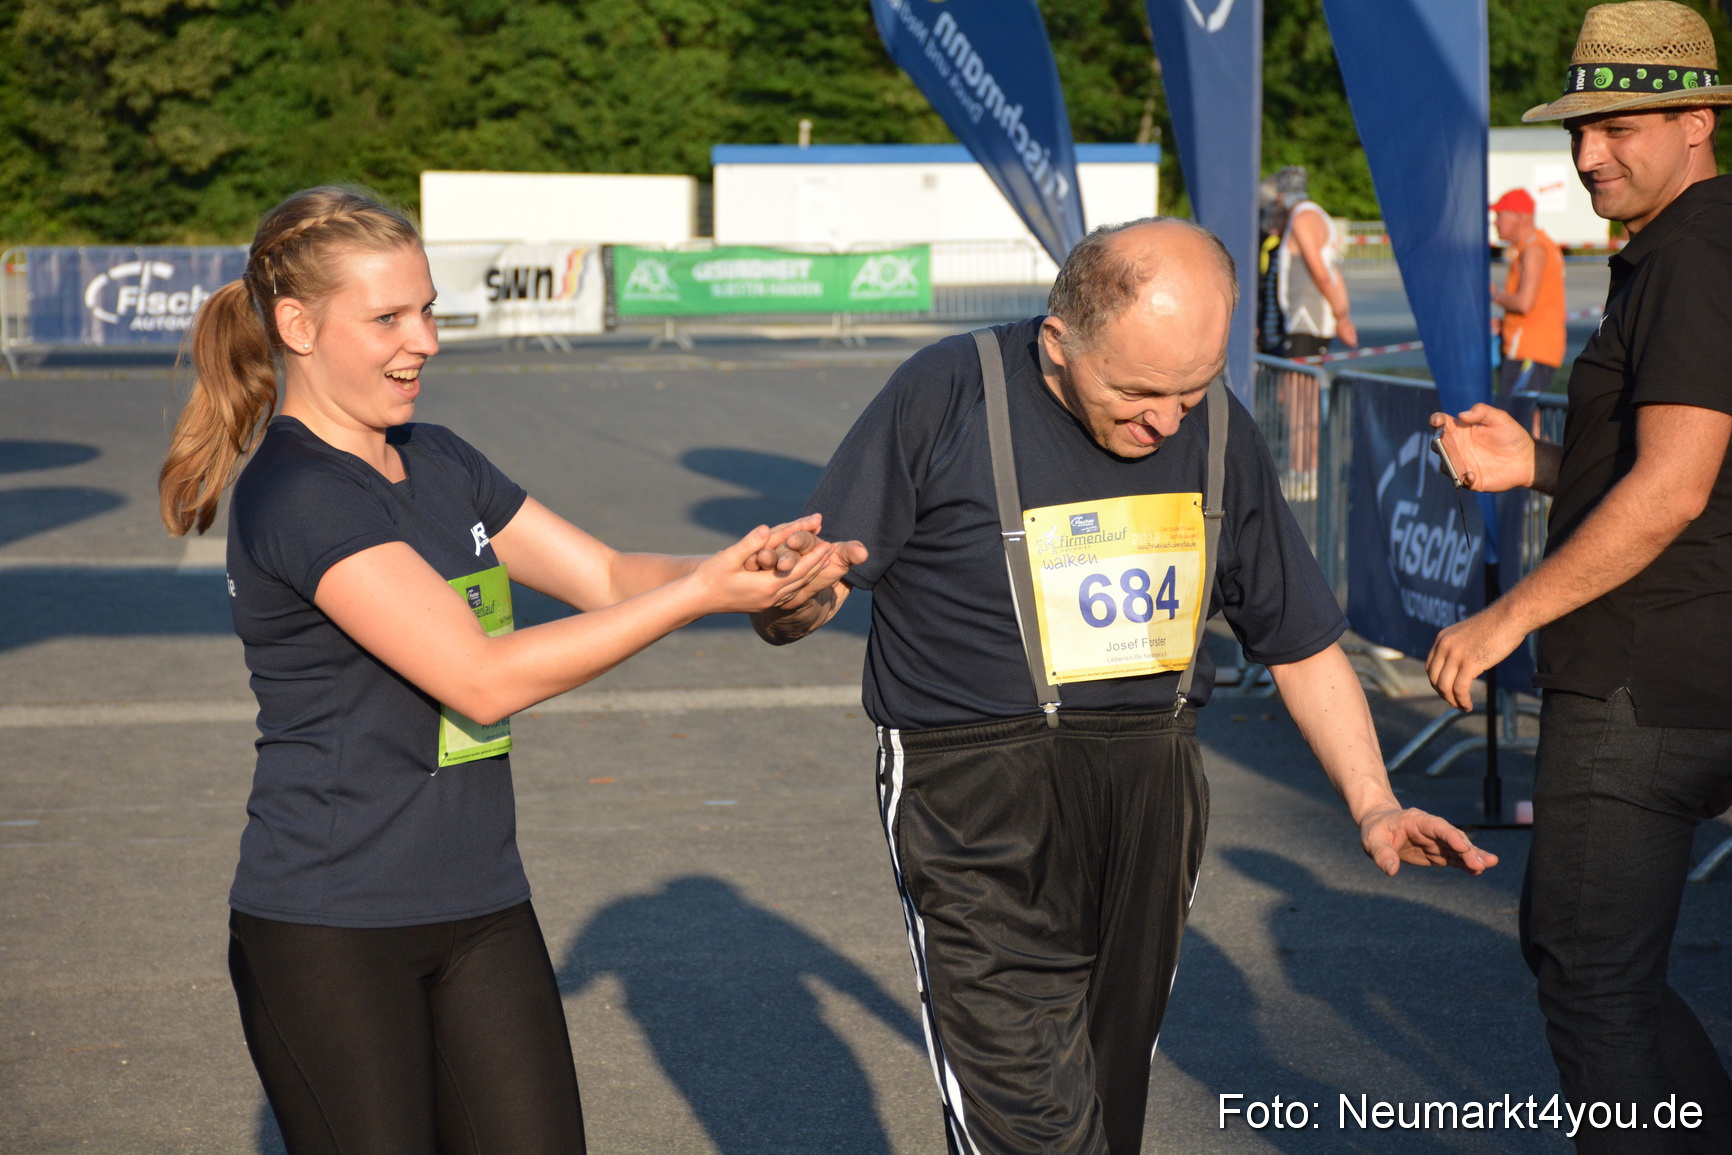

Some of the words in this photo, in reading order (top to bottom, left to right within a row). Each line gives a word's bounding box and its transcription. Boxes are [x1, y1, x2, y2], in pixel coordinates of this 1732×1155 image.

[1576, 69, 1586, 91] now
[849, 254, 920, 291] AOK
[116, 284, 212, 317] Fisch
[129, 315, 193, 332] AUTOM
[1059, 527, 1128, 548] firmenlauf
[1390, 499, 1483, 588] Fischer
[1042, 552, 1099, 570] walken
[1078, 565, 1180, 629] 684
[1401, 588, 1469, 628] UTOMOBILE
[1105, 639, 1139, 652] Josef
